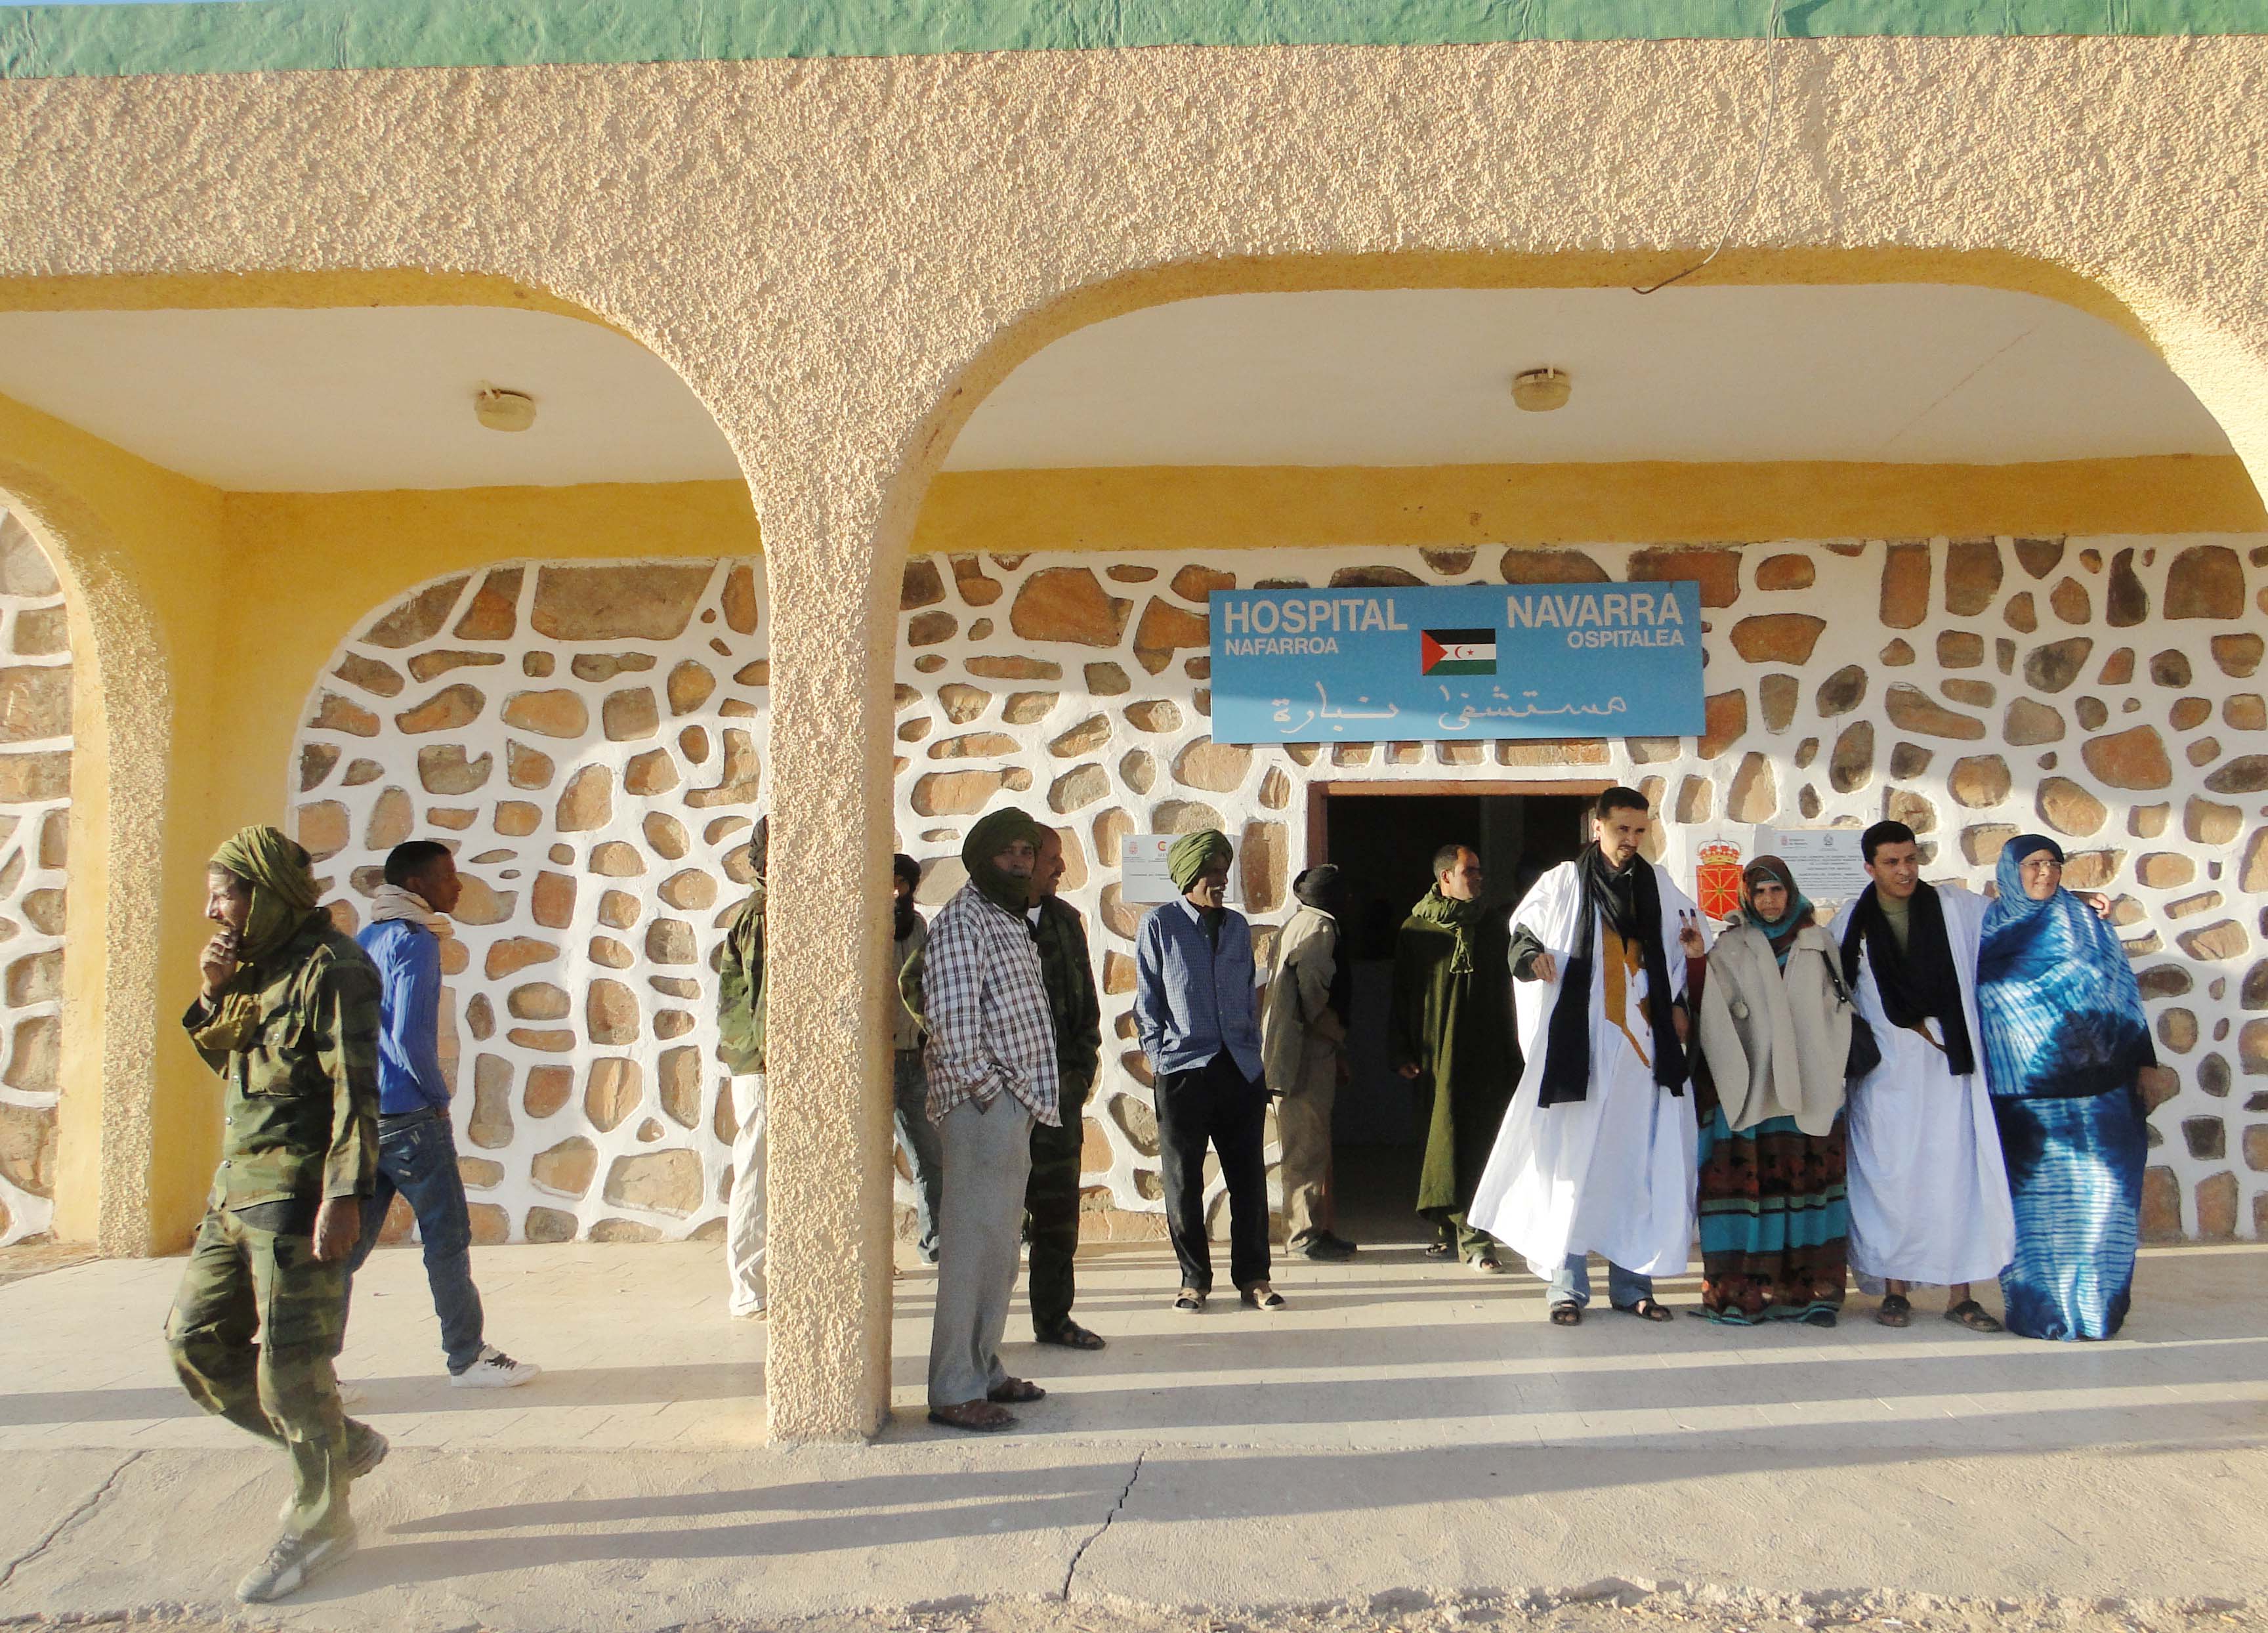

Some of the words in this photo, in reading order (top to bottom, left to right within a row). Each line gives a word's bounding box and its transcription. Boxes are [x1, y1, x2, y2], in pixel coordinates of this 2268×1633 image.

[1224, 598, 1408, 634] HOSPITAL
[1507, 593, 1683, 628] NAVARRA
[1225, 637, 1339, 656] NAFARROA
[1567, 628, 1685, 648] OSPITALEA
